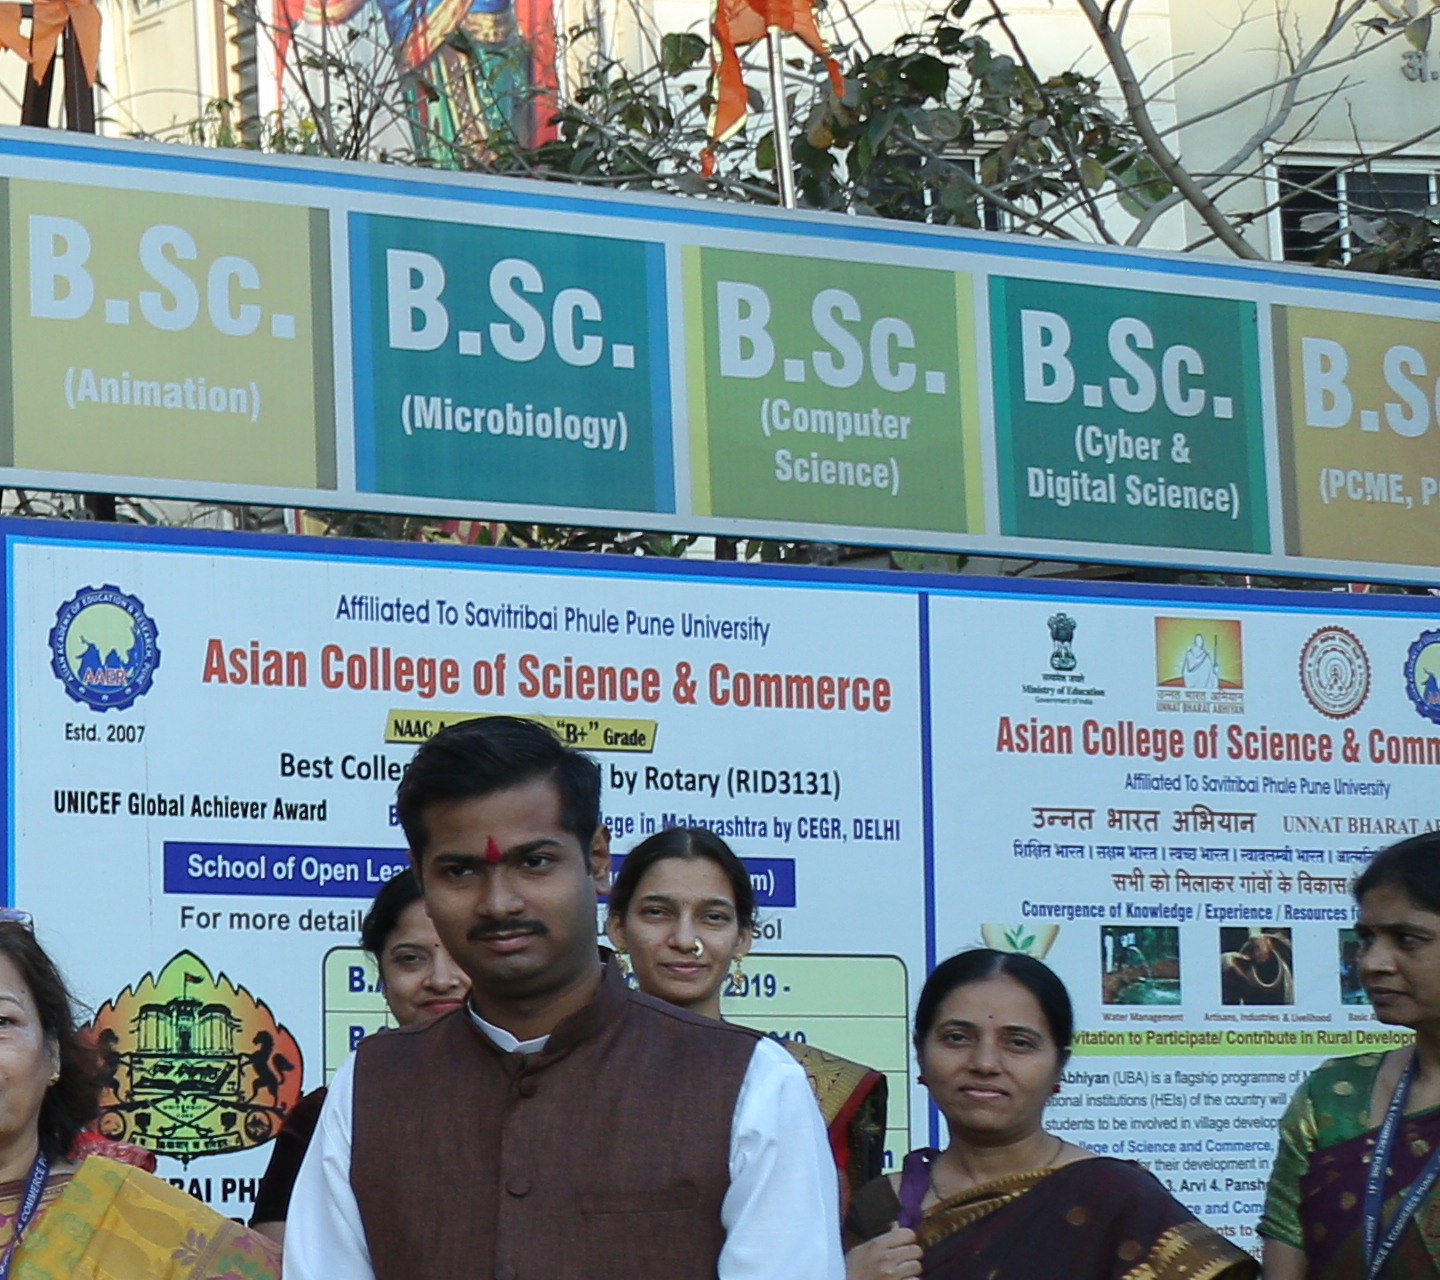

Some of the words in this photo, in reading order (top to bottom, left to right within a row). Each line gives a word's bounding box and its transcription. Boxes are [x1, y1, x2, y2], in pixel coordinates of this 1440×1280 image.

[28, 214, 297, 340] B.Sc.
[386, 248, 636, 370] B.Sc.
[715, 280, 947, 395] B.Sc.
[1020, 308, 1234, 420] B.Sc.
[1300, 336, 1440, 439] B.S
[63, 366, 262, 424] (Animation)
[400, 395, 629, 454] (Microbiology)
[759, 397, 912, 443] (Computer
[1073, 423, 1162, 466] (Cyber
[1171, 432, 1192, 464] &
[775, 447, 900, 496] Science)
[1027, 466, 1118, 506] Digital
[1126, 465, 1240, 520] Science)
[1318, 466, 1414, 509] (PCME,
[336, 594, 430, 625] Affiliated
[436, 600, 459, 626] To
[464, 601, 558, 632] Savitribai
[565, 609, 620, 635] Phule
[626, 610, 675, 638] Pune
[681, 613, 771, 647] University
[83, 667, 127, 687] AAER
[202, 638, 307, 687] Asian
[320, 643, 460, 700] College
[473, 653, 507, 698] of
[518, 653, 661, 704] Science
[673, 661, 697, 706] &
[709, 663, 891, 713] Commerce
[64, 722, 102, 742] Estd.
[107, 723, 146, 744] 2007
[393, 718, 433, 738] NAAC
[604, 727, 647, 747] Grade
[996, 716, 1073, 754] Asian
[1082, 720, 1185, 763] College
[1194, 724, 1219, 759] of
[1226, 724, 1333, 762] Science
[1343, 728, 1361, 762] &
[1369, 729, 1440, 766] Comm
[281, 752, 333, 779] Best
[610, 765, 639, 795] by
[645, 766, 721, 798] Rotary
[727, 770, 841, 802] (RID3131)
[54, 790, 122, 815] UNICEF
[128, 793, 185, 818] Global
[190, 794, 267, 820] Achiever
[273, 796, 328, 822] Award
[1031, 806, 1096, 831] उन्नत
[1106, 808, 1162, 832] भारत
[1171, 803, 1258, 834] अभियान
[187, 853, 268, 882] School
[272, 856, 296, 881] of
[300, 857, 360, 887] Open
[1111, 871, 1145, 894] सभी
[1150, 872, 1171, 893] को
[1175, 871, 1235, 894] मिलाकर
[1277, 873, 1292, 894] के
[1297, 875, 1348, 896] विकास
[180, 906, 223, 929] For
[229, 911, 291, 931] more
[298, 909, 367, 932] detail
[1021, 900, 1106, 920] Convergence
[1109, 902, 1123, 919] of
[1125, 902, 1194, 923] Knowledge
[1205, 903, 1275, 923] Experience
[1284, 905, 1348, 923] Resources
